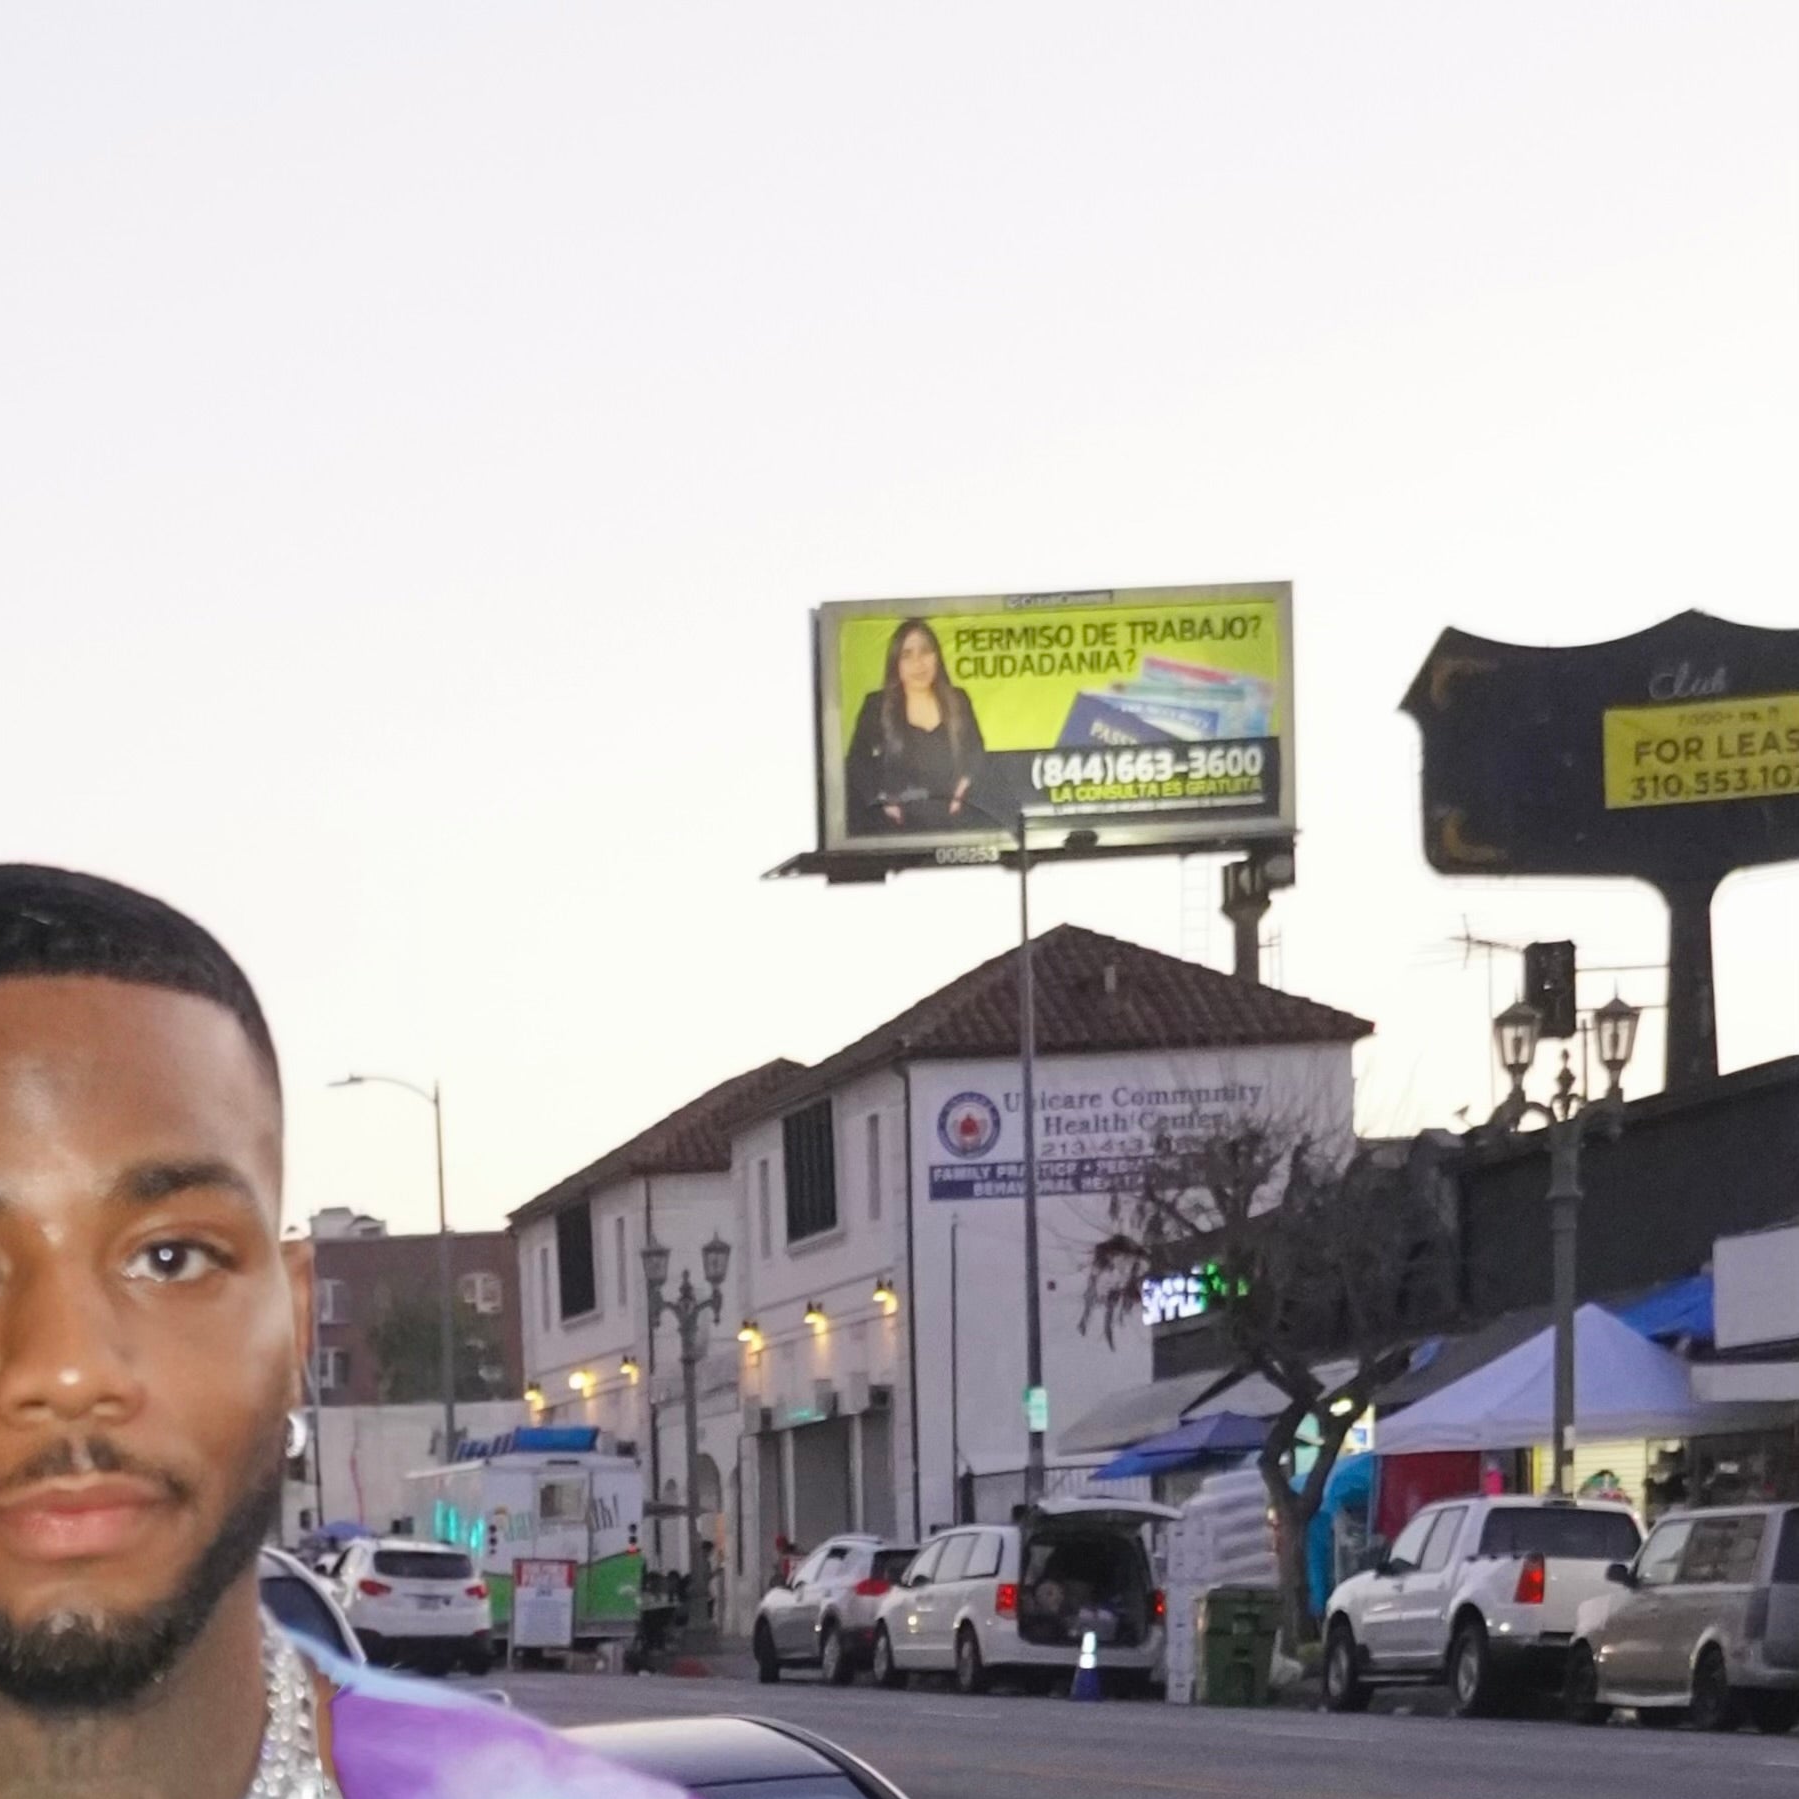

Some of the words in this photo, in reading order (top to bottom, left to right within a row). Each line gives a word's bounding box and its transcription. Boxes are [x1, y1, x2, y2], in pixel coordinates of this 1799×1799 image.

[954, 624, 1074, 652] PERMISO
[1082, 622, 1117, 648] DE
[1127, 614, 1262, 644] TRABAJO?
[955, 648, 1137, 680] CIUDADANIA?
[1634, 736, 1704, 766] FOR
[1031, 745, 1265, 790] (844)663-3600
[1630, 763, 1799, 801] 310.553.10
[1052, 786, 1073, 803] LA
[1075, 781, 1160, 802] CONSULTA
[1162, 780, 1182, 797] ES
[1185, 776, 1263, 796] GRATUITA
[1003, 1090, 1102, 1113] Uicare
[1112, 1084, 1263, 1108] Community
[1044, 1113, 1129, 1137] Health
[934, 1166, 992, 1182] FAMILY
[996, 1160, 1078, 1180] PRATICE
